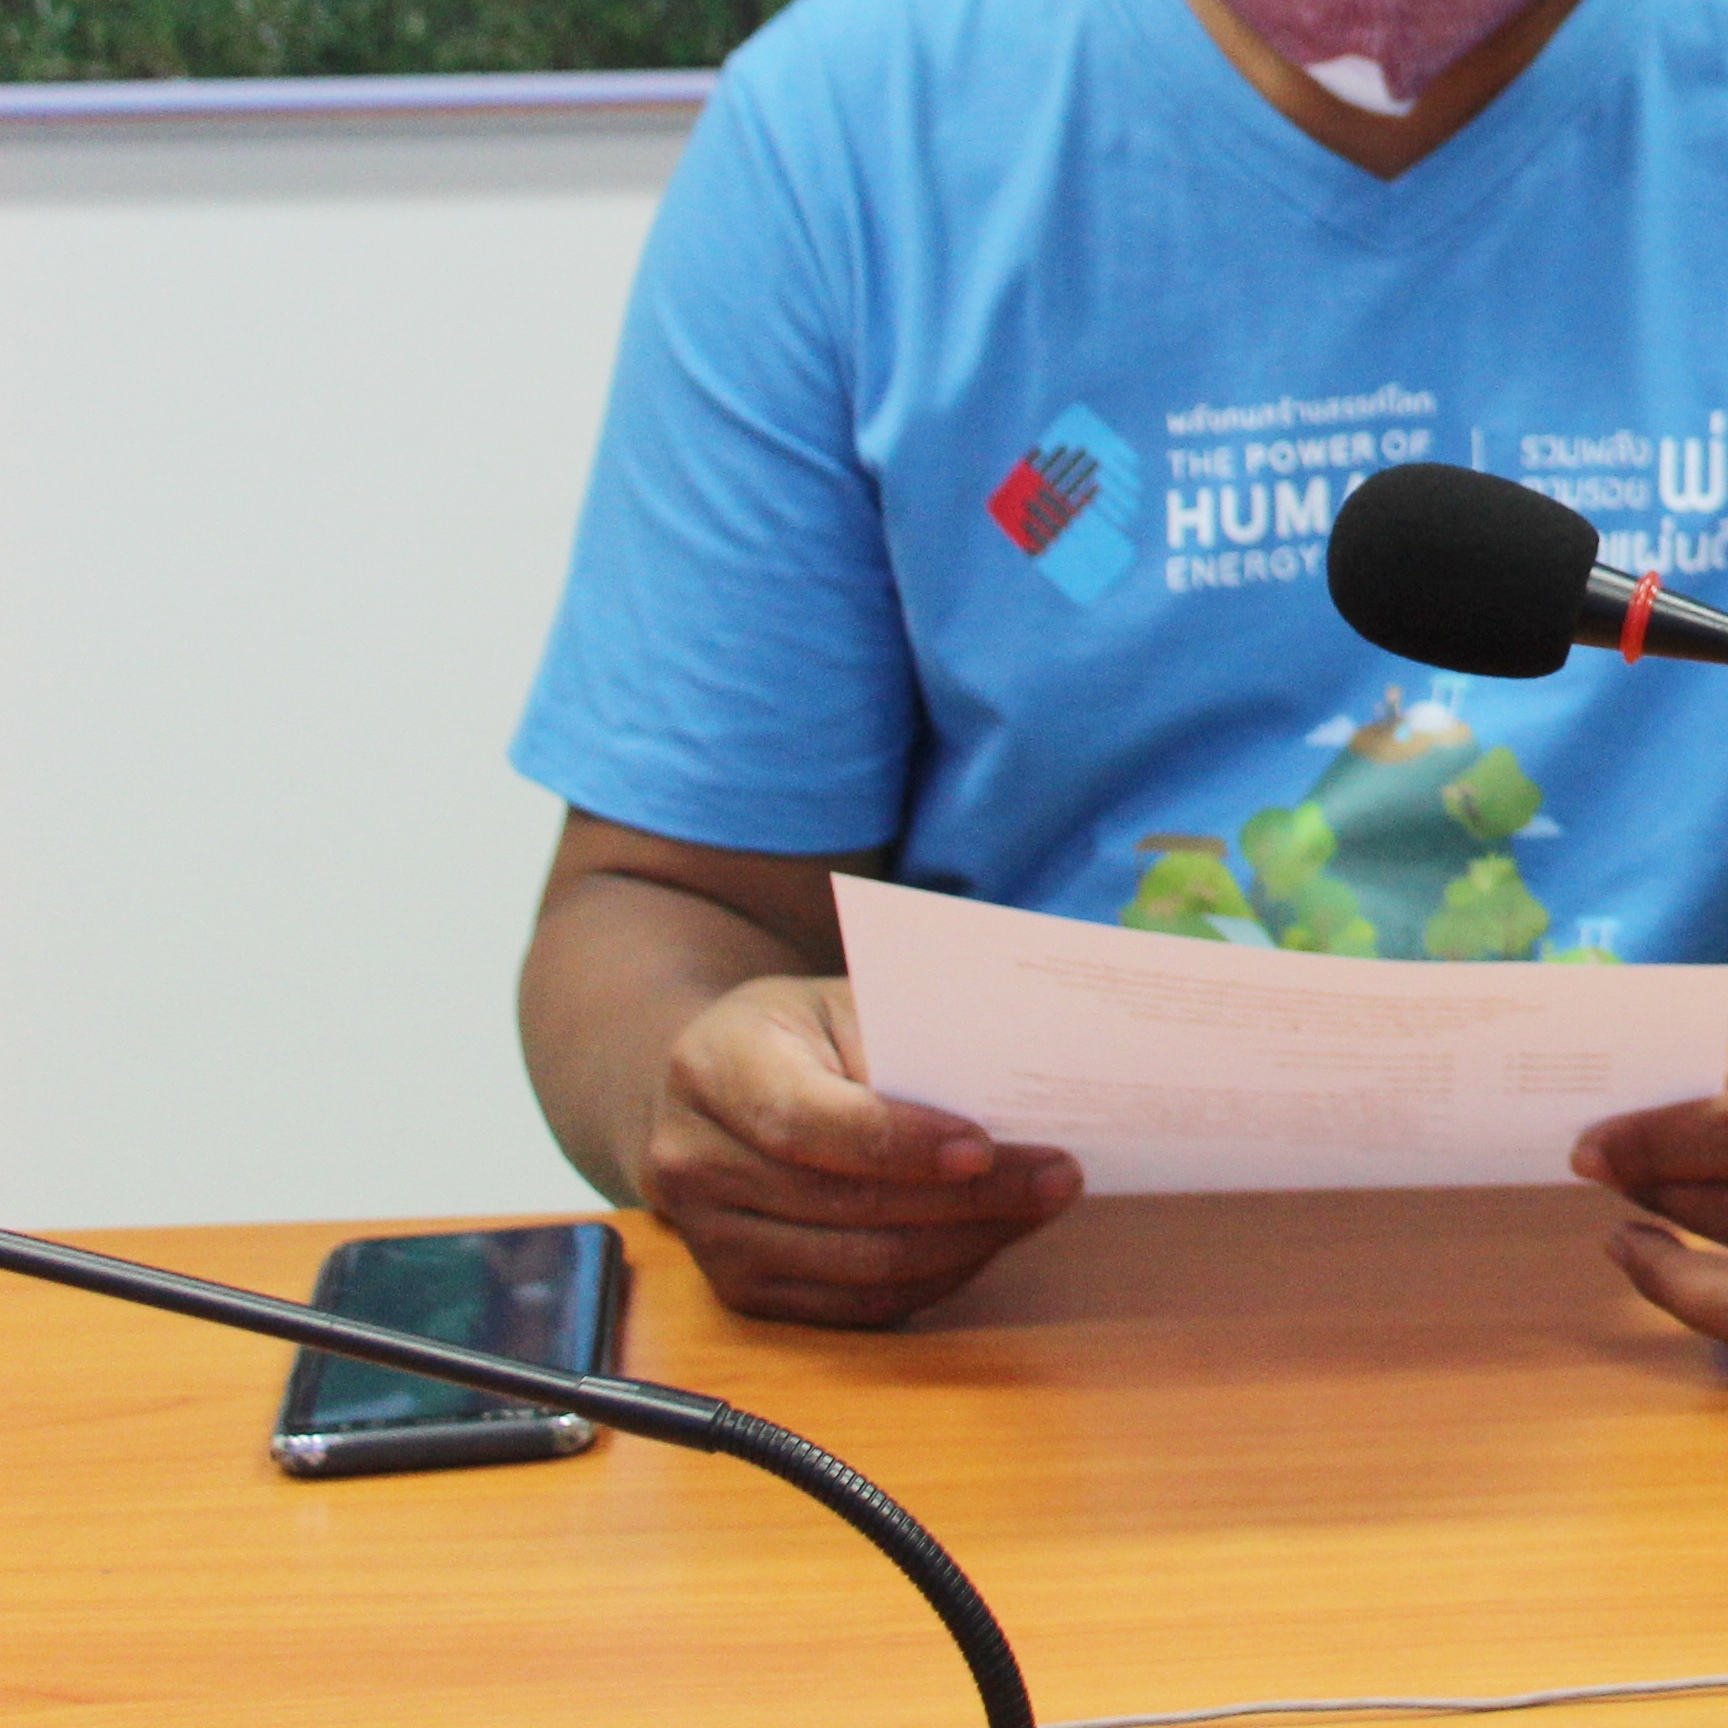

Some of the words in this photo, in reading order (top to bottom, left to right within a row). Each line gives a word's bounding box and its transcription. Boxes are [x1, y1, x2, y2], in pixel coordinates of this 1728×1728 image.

[1168, 445, 1234, 480] THE
[1245, 432, 1375, 476] POWER
[1381, 427, 1432, 463] OF
[1166, 472, 1367, 549] HUM
[1165, 542, 1322, 593] ENERGY
